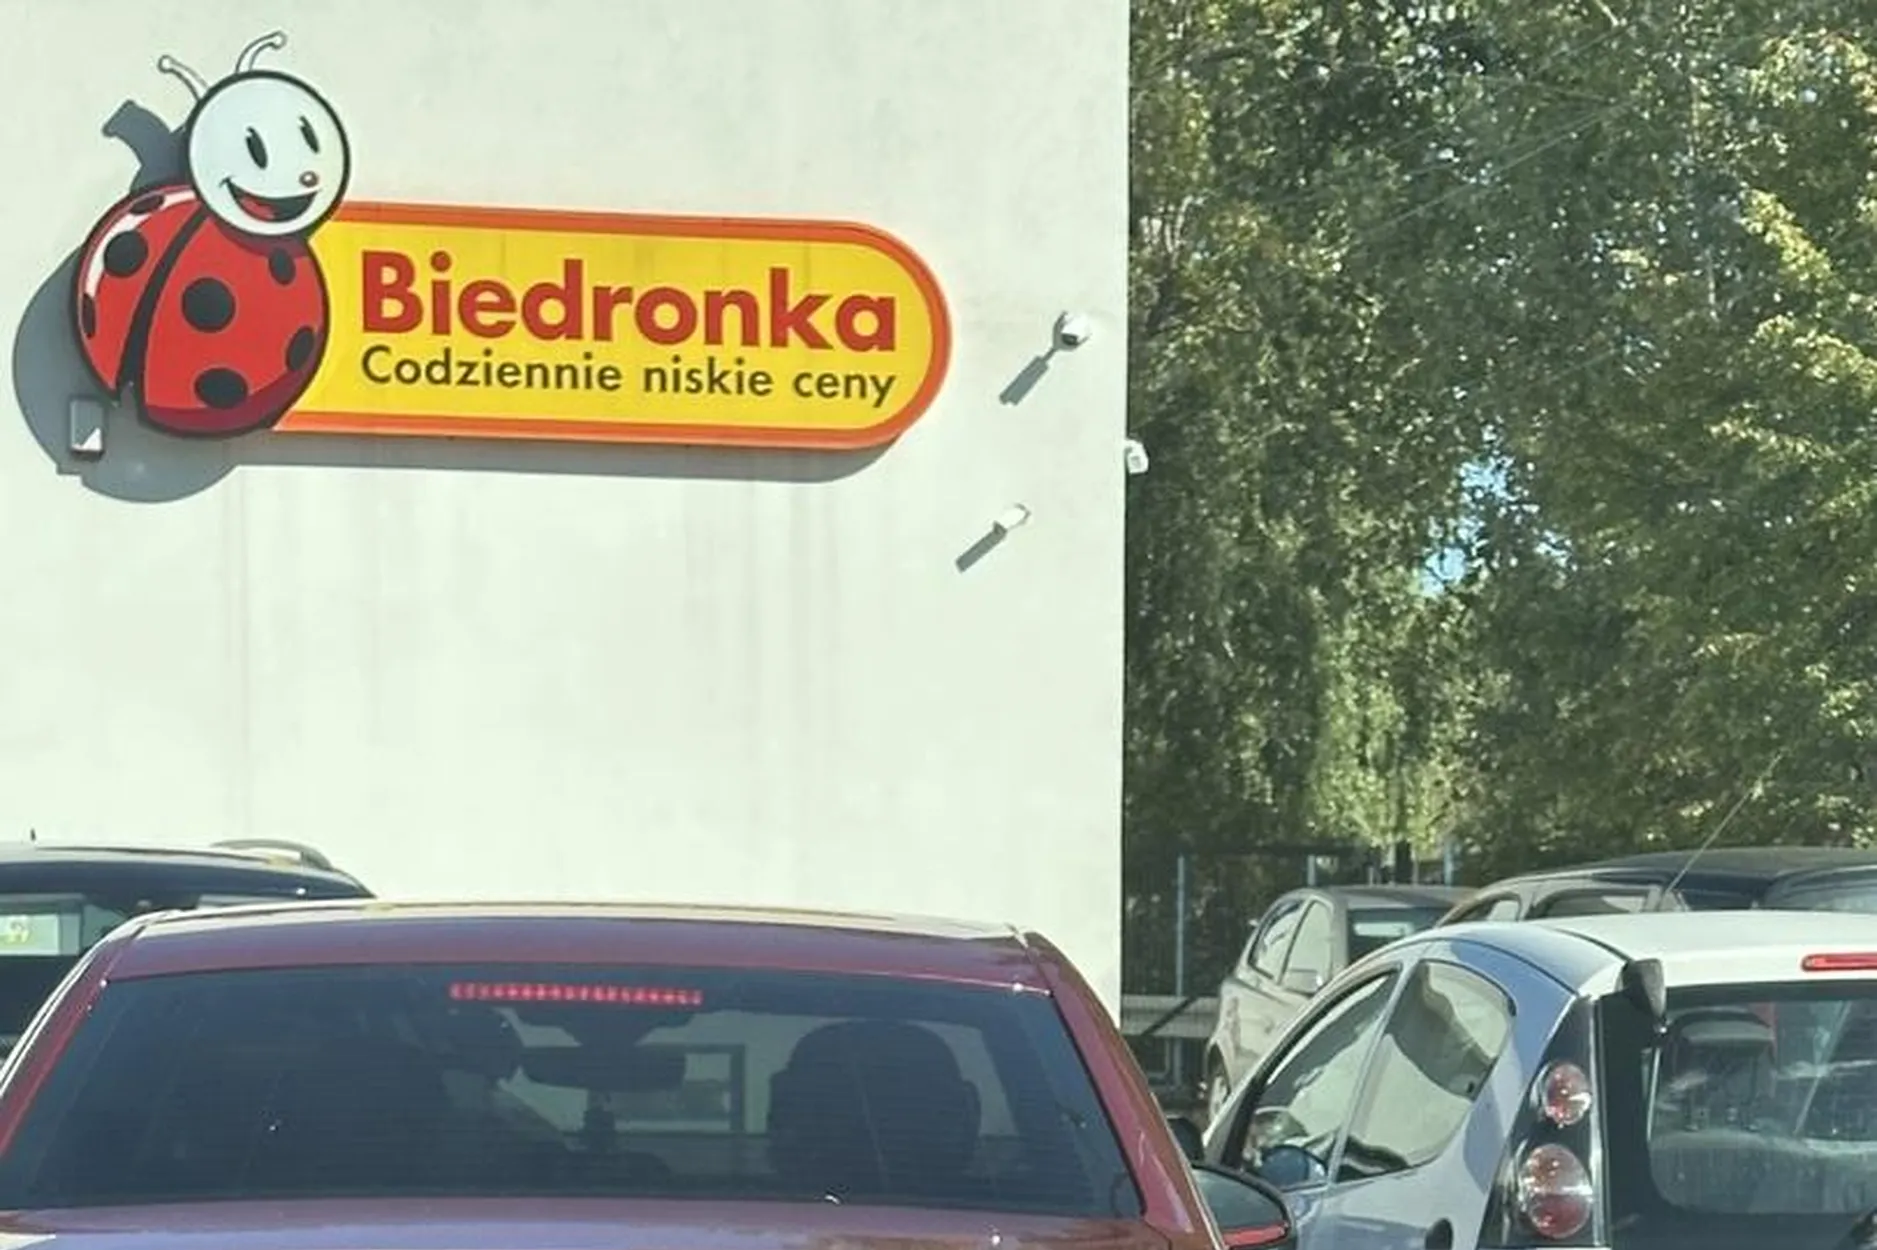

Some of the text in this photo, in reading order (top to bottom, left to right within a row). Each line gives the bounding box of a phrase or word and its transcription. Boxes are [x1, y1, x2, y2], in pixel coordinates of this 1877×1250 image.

[361, 249, 896, 352] Biedronka
[361, 344, 896, 408] Codziennie niskie ceny
